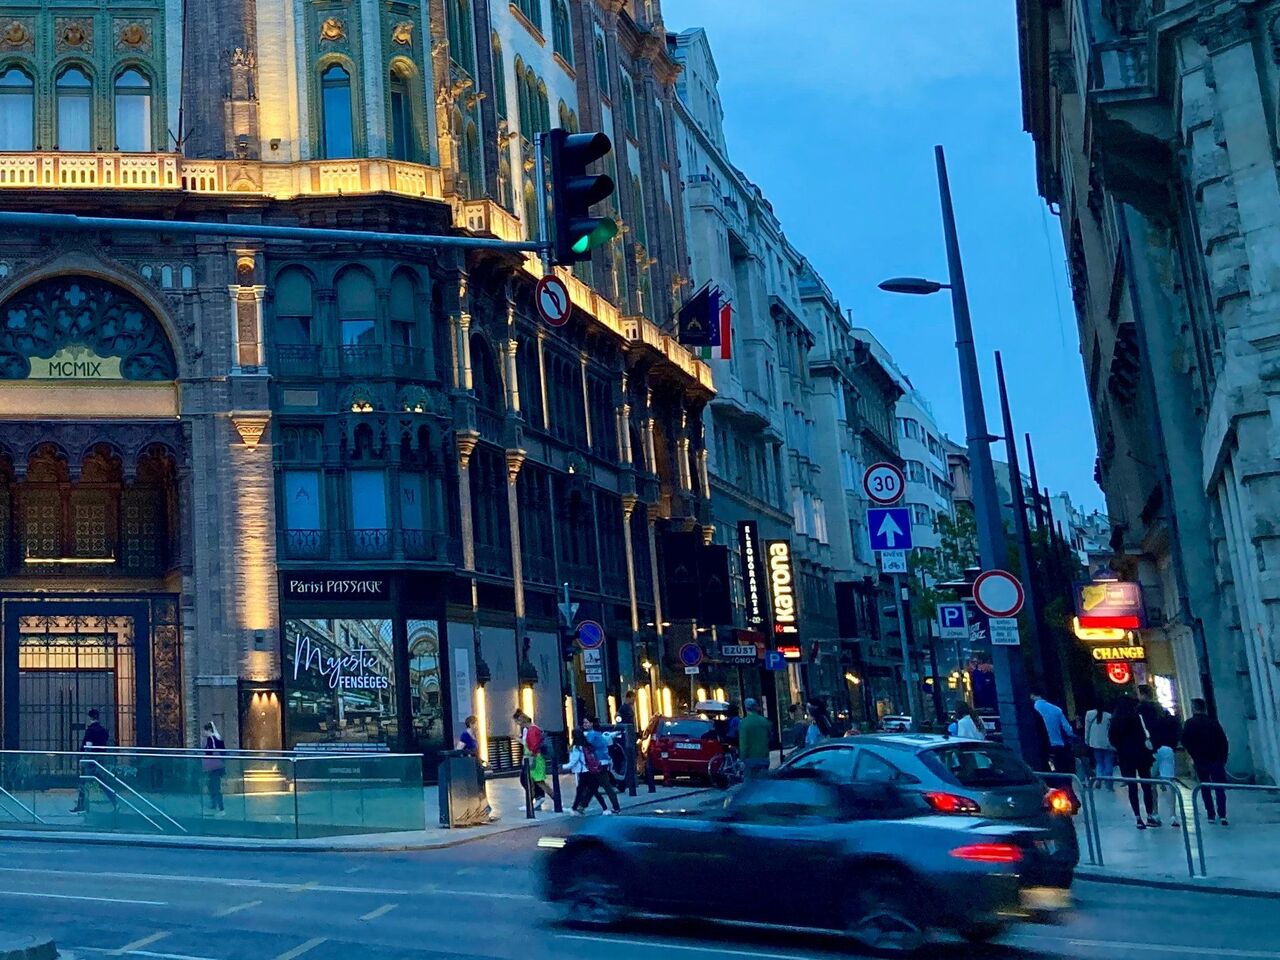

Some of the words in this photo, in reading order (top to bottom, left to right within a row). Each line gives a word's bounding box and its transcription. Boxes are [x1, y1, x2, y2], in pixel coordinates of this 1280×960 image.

[49, 361, 101, 377] MCMIX
[873, 475, 895, 492] 30
[290, 580, 323, 593] Párisi
[327, 580, 382, 593] PASSAGE
[944, 608, 959, 626] P
[294, 633, 380, 689] Majestic
[769, 653, 780, 668] P
[1092, 646, 1145, 660] CHANGE
[339, 673, 388, 689] FENSÉGES
